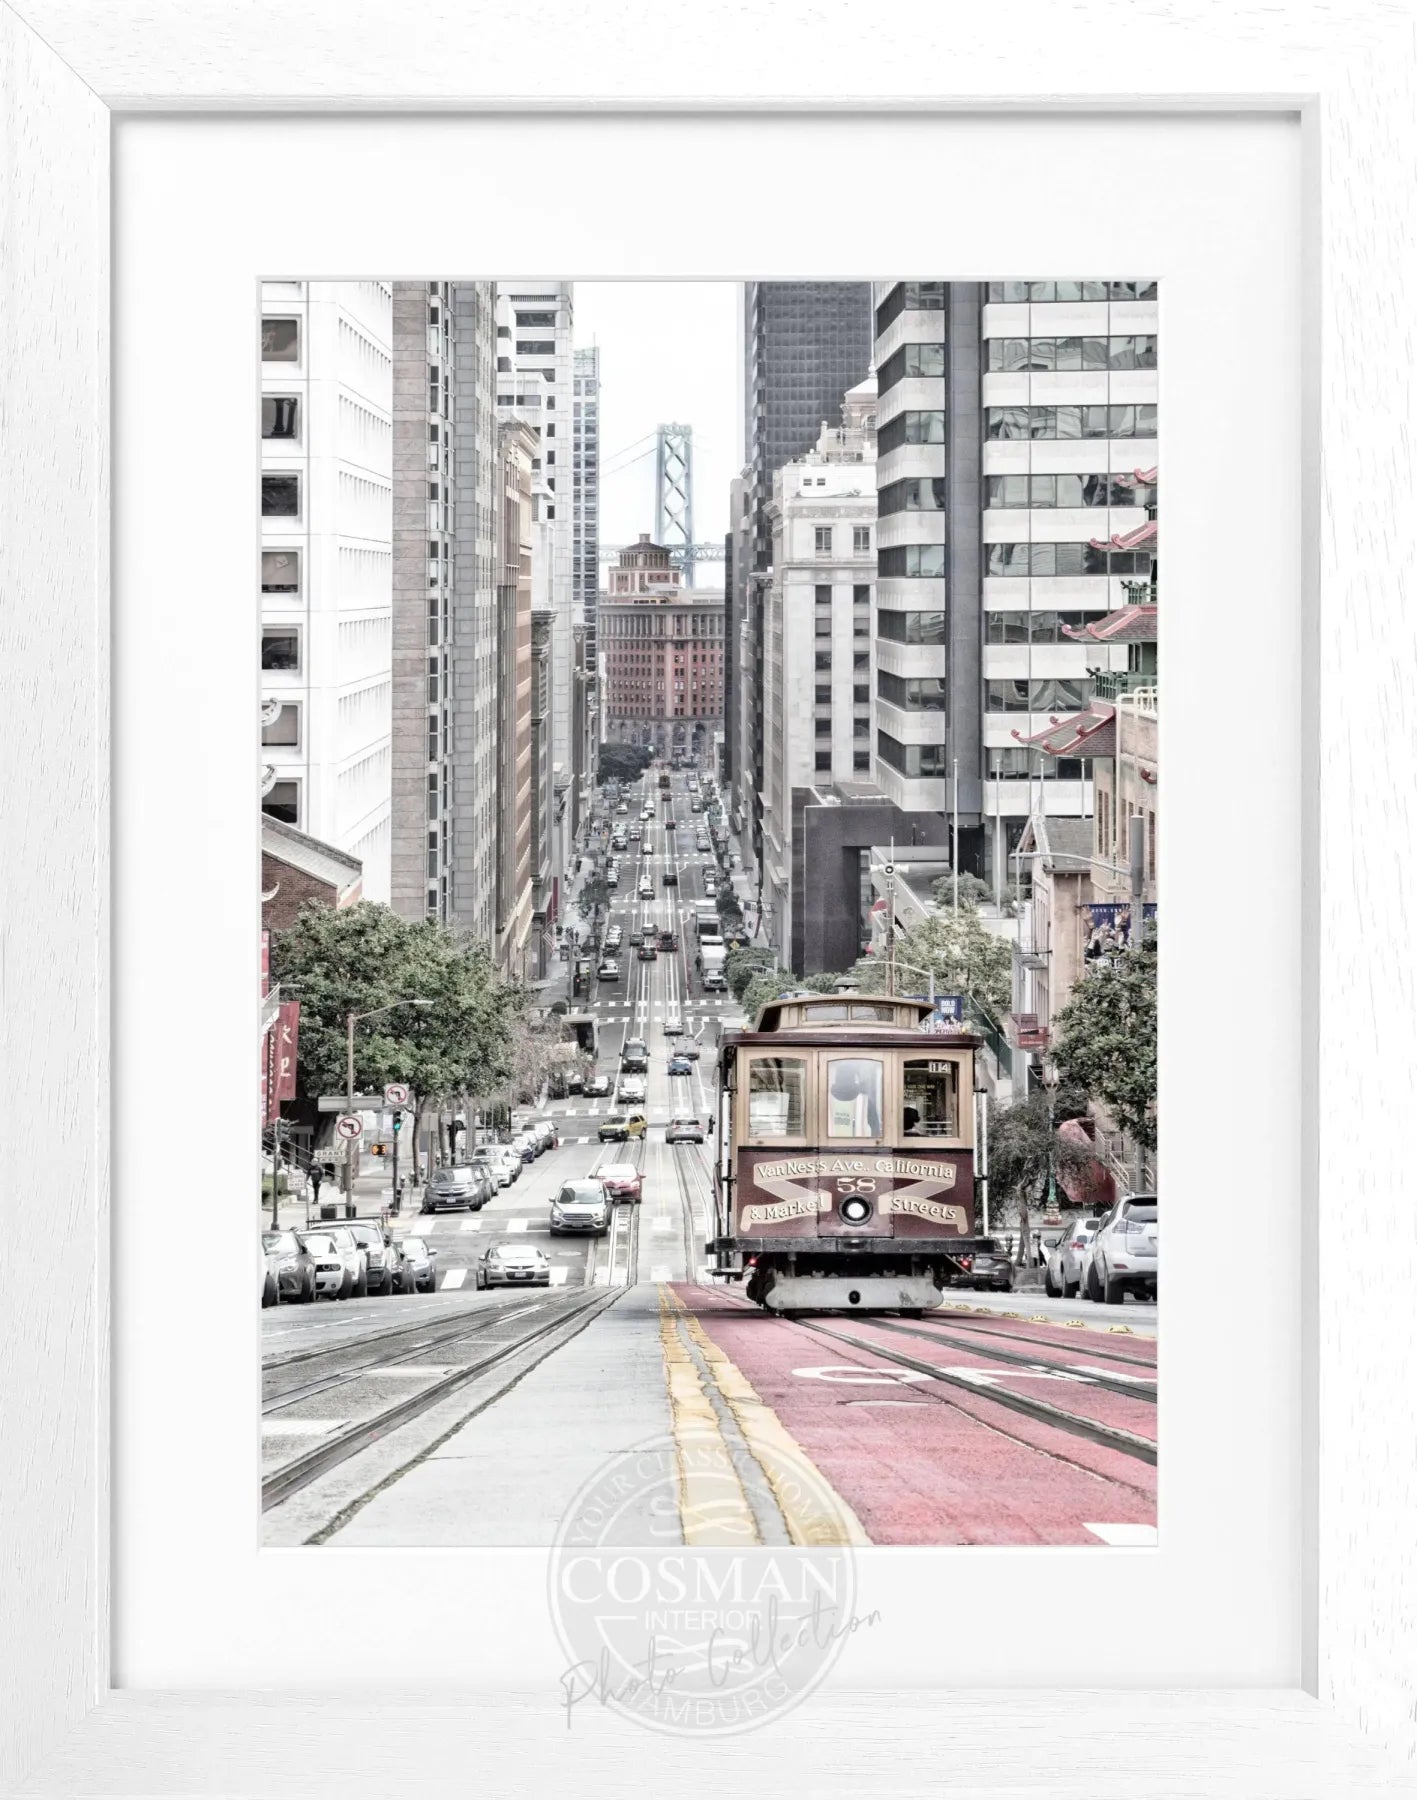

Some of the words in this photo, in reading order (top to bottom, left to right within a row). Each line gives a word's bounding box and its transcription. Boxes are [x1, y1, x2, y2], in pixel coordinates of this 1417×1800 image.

[757, 1165, 785, 1178] Van
[786, 1160, 827, 1174] Ness
[875, 1159, 953, 1179] California
[837, 1177, 876, 1193] 58
[750, 1207, 760, 1219] &
[764, 1195, 824, 1220] Market
[891, 1198, 957, 1220] Streets
